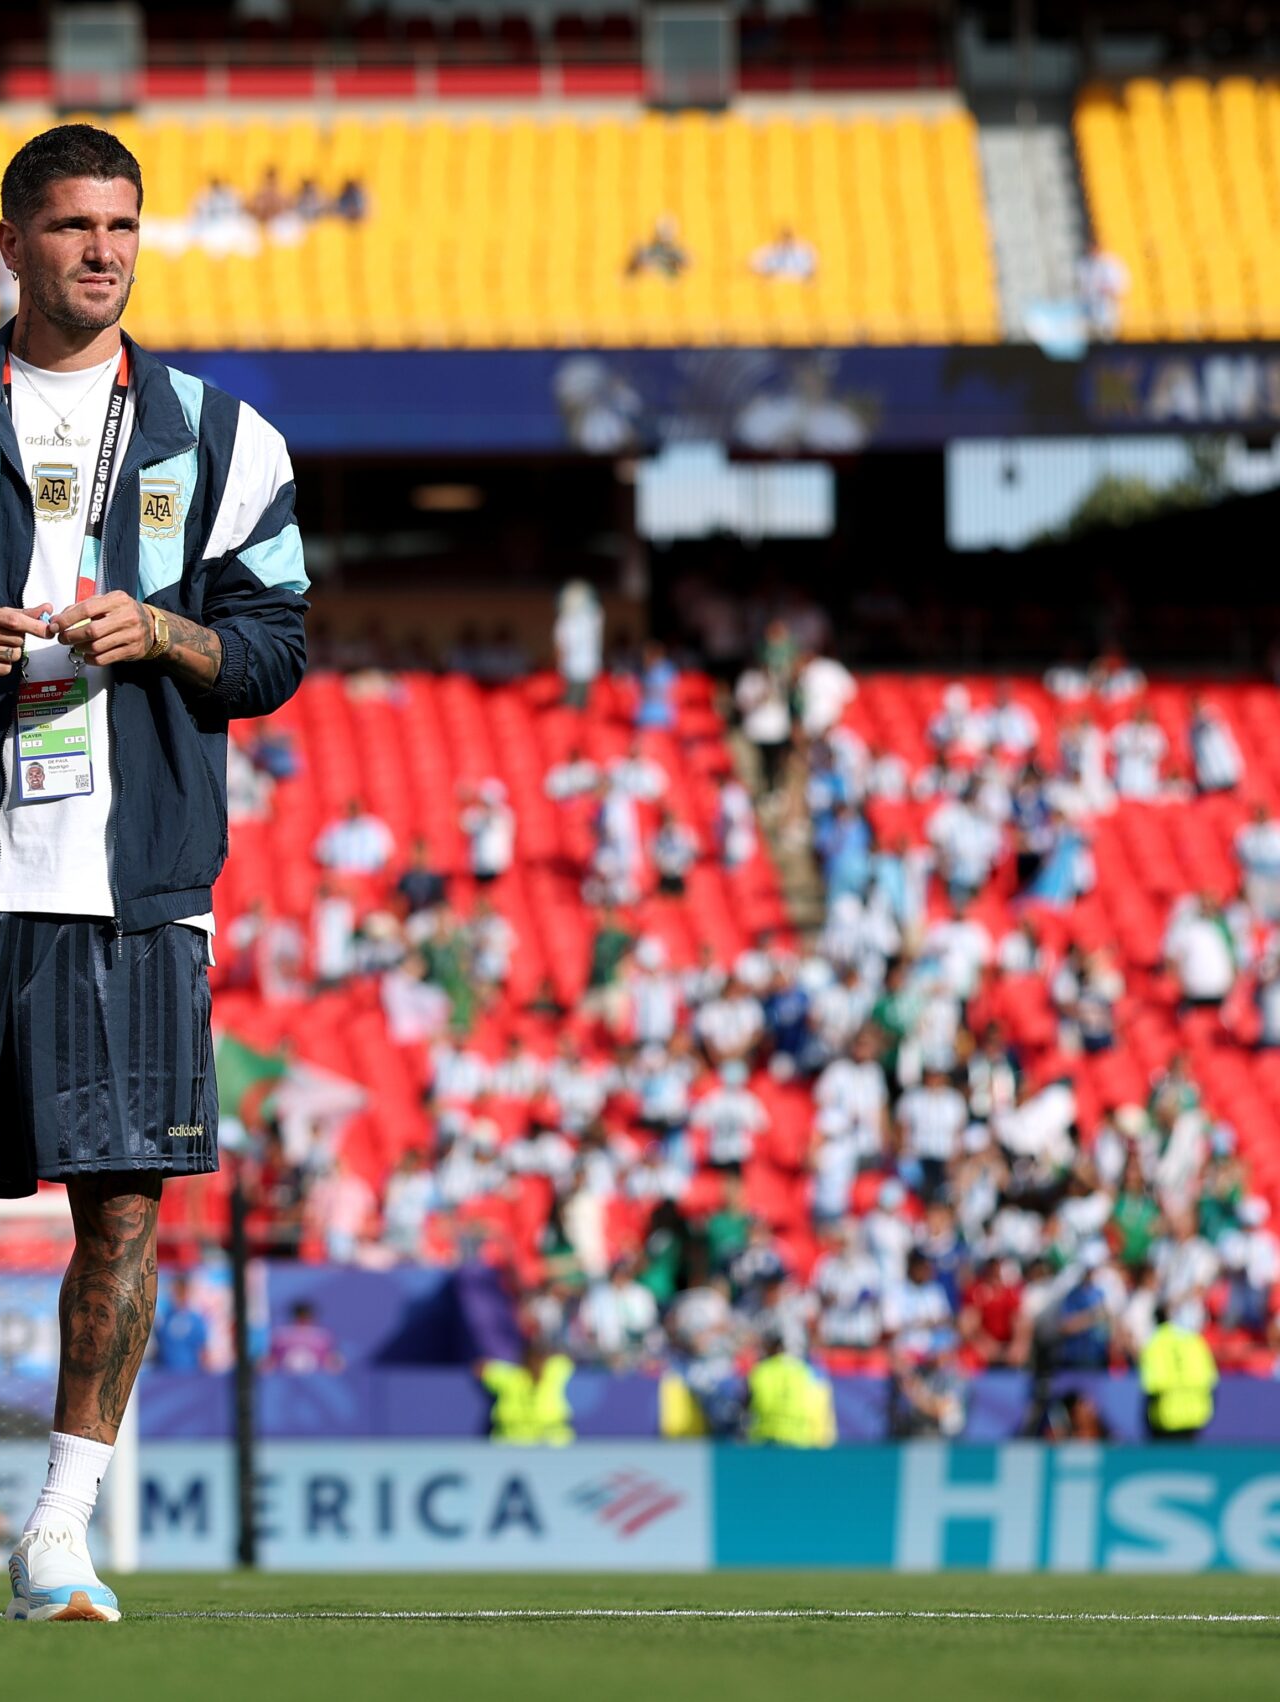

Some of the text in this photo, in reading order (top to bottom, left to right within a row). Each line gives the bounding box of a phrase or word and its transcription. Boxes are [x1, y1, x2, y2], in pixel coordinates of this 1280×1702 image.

[1094, 354, 1280, 425] KAN
[25, 434, 72, 447] adidas
[90, 394, 123, 525] FIFA WORLD CUP 2026
[39, 477, 68, 506] AFA
[143, 493, 172, 522] AFA
[167, 1124, 197, 1137] adidas
[140, 1471, 544, 1542] MERICA
